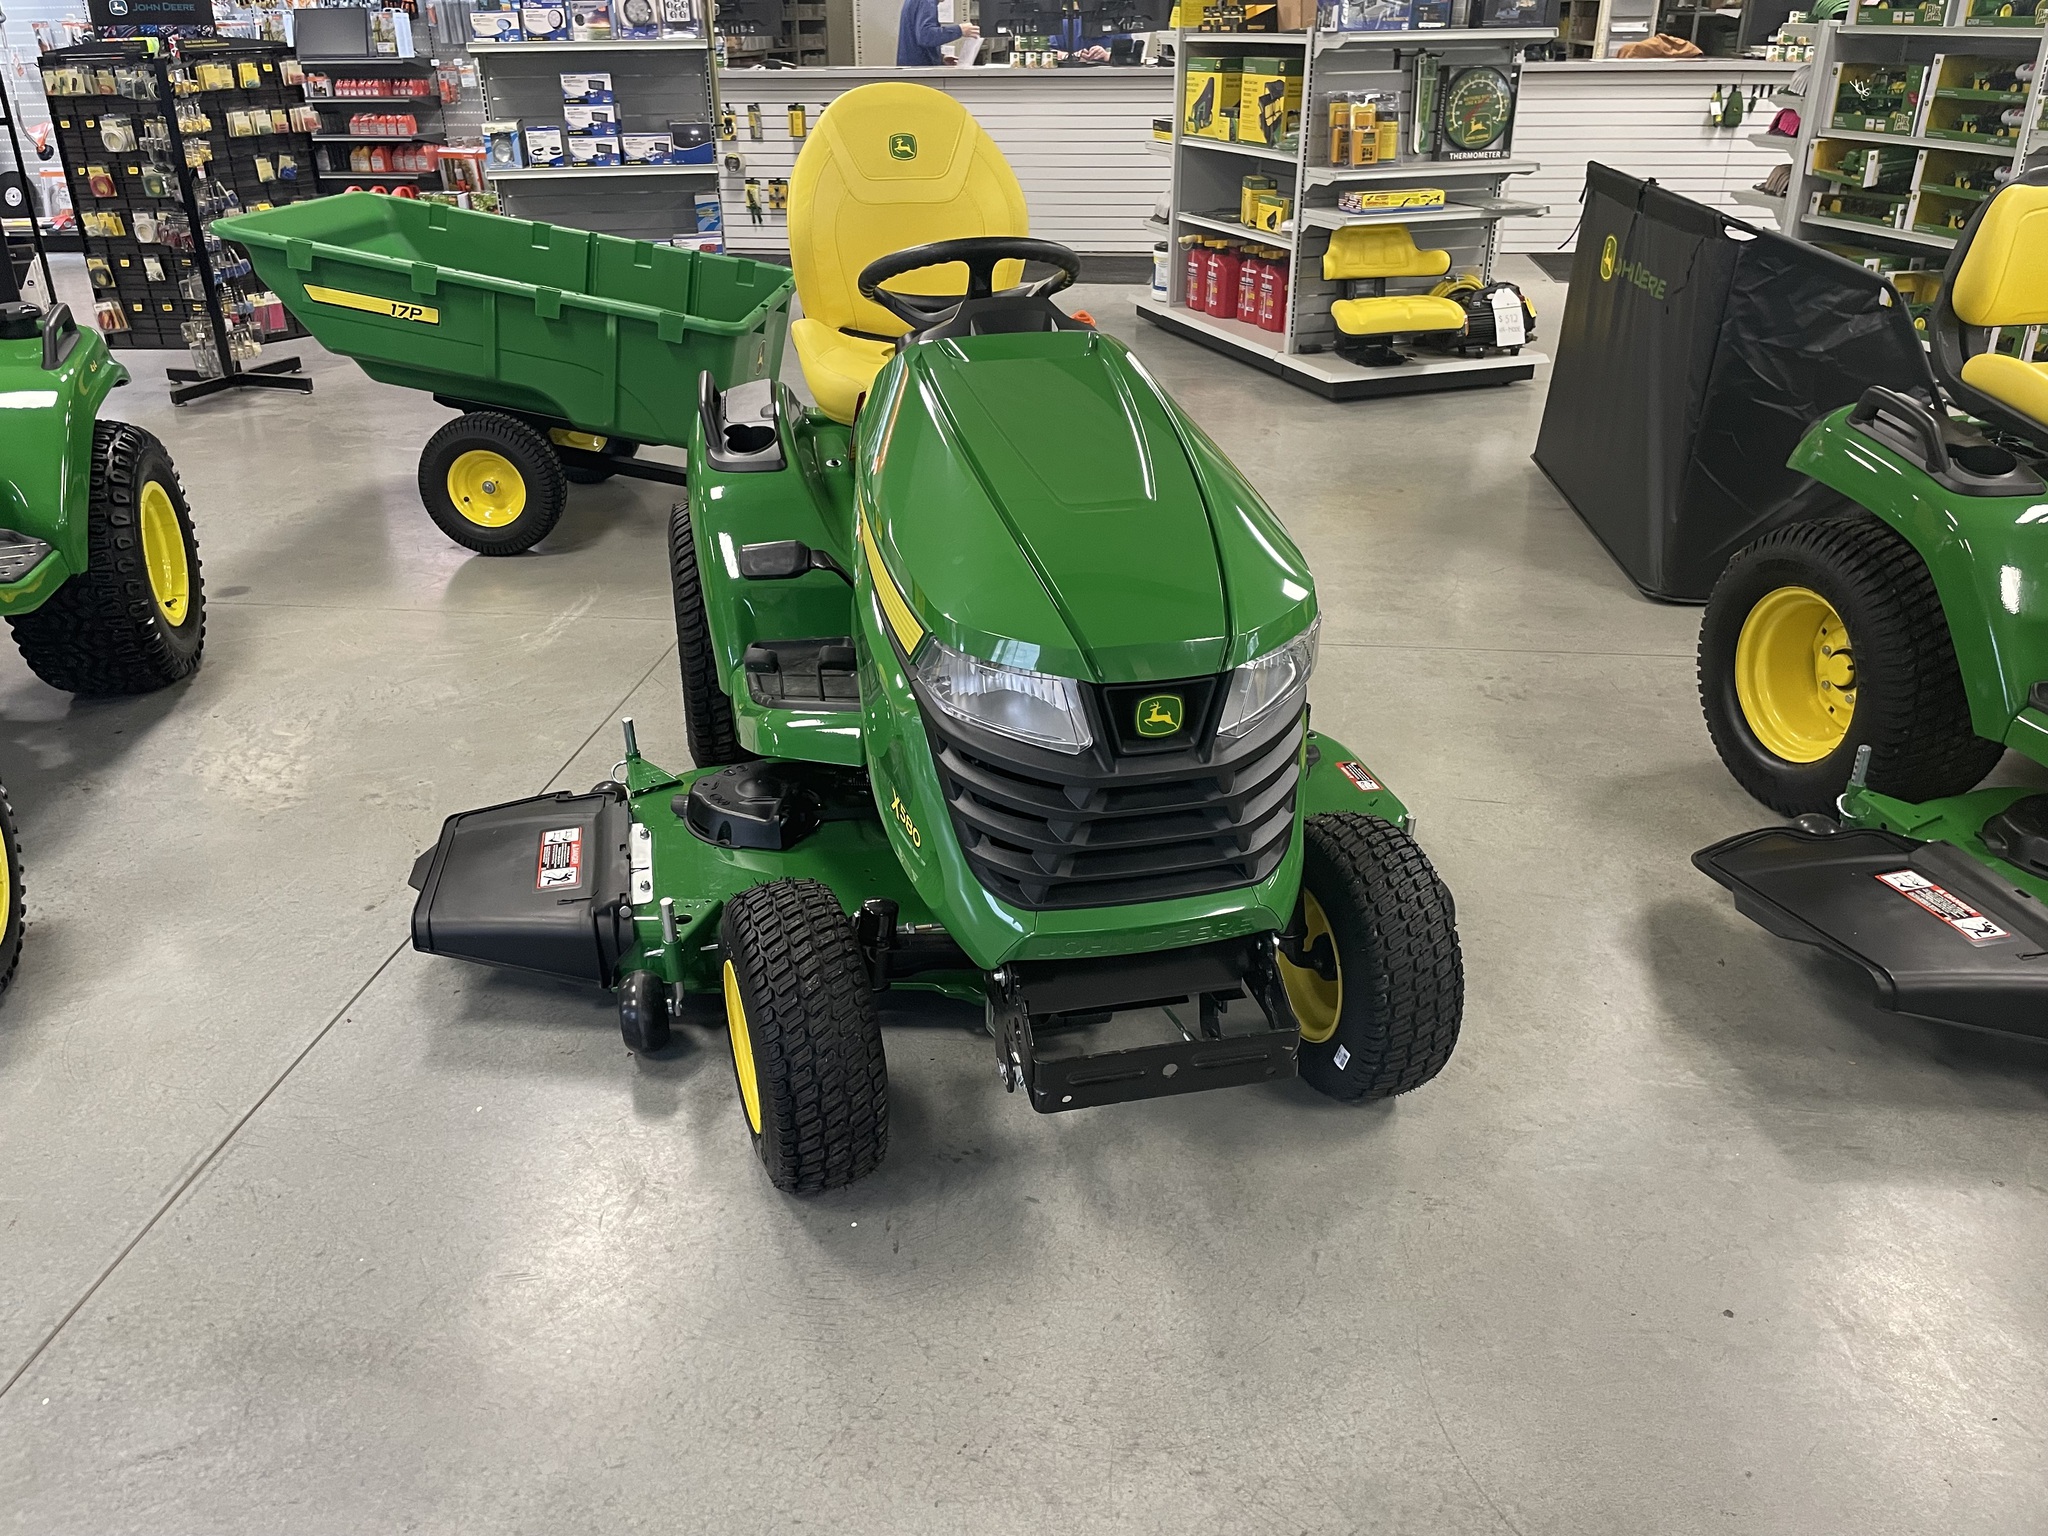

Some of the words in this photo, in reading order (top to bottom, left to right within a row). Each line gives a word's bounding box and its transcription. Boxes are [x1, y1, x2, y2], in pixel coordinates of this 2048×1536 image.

[132, 2, 161, 12] JOHN
[162, 3, 196, 12] DEERE
[1436, 83, 1447, 145] THERMOMETER
[1449, 151, 1501, 160] THERMOMETER
[391, 303, 423, 319] 17P
[890, 786, 921, 848] X580
